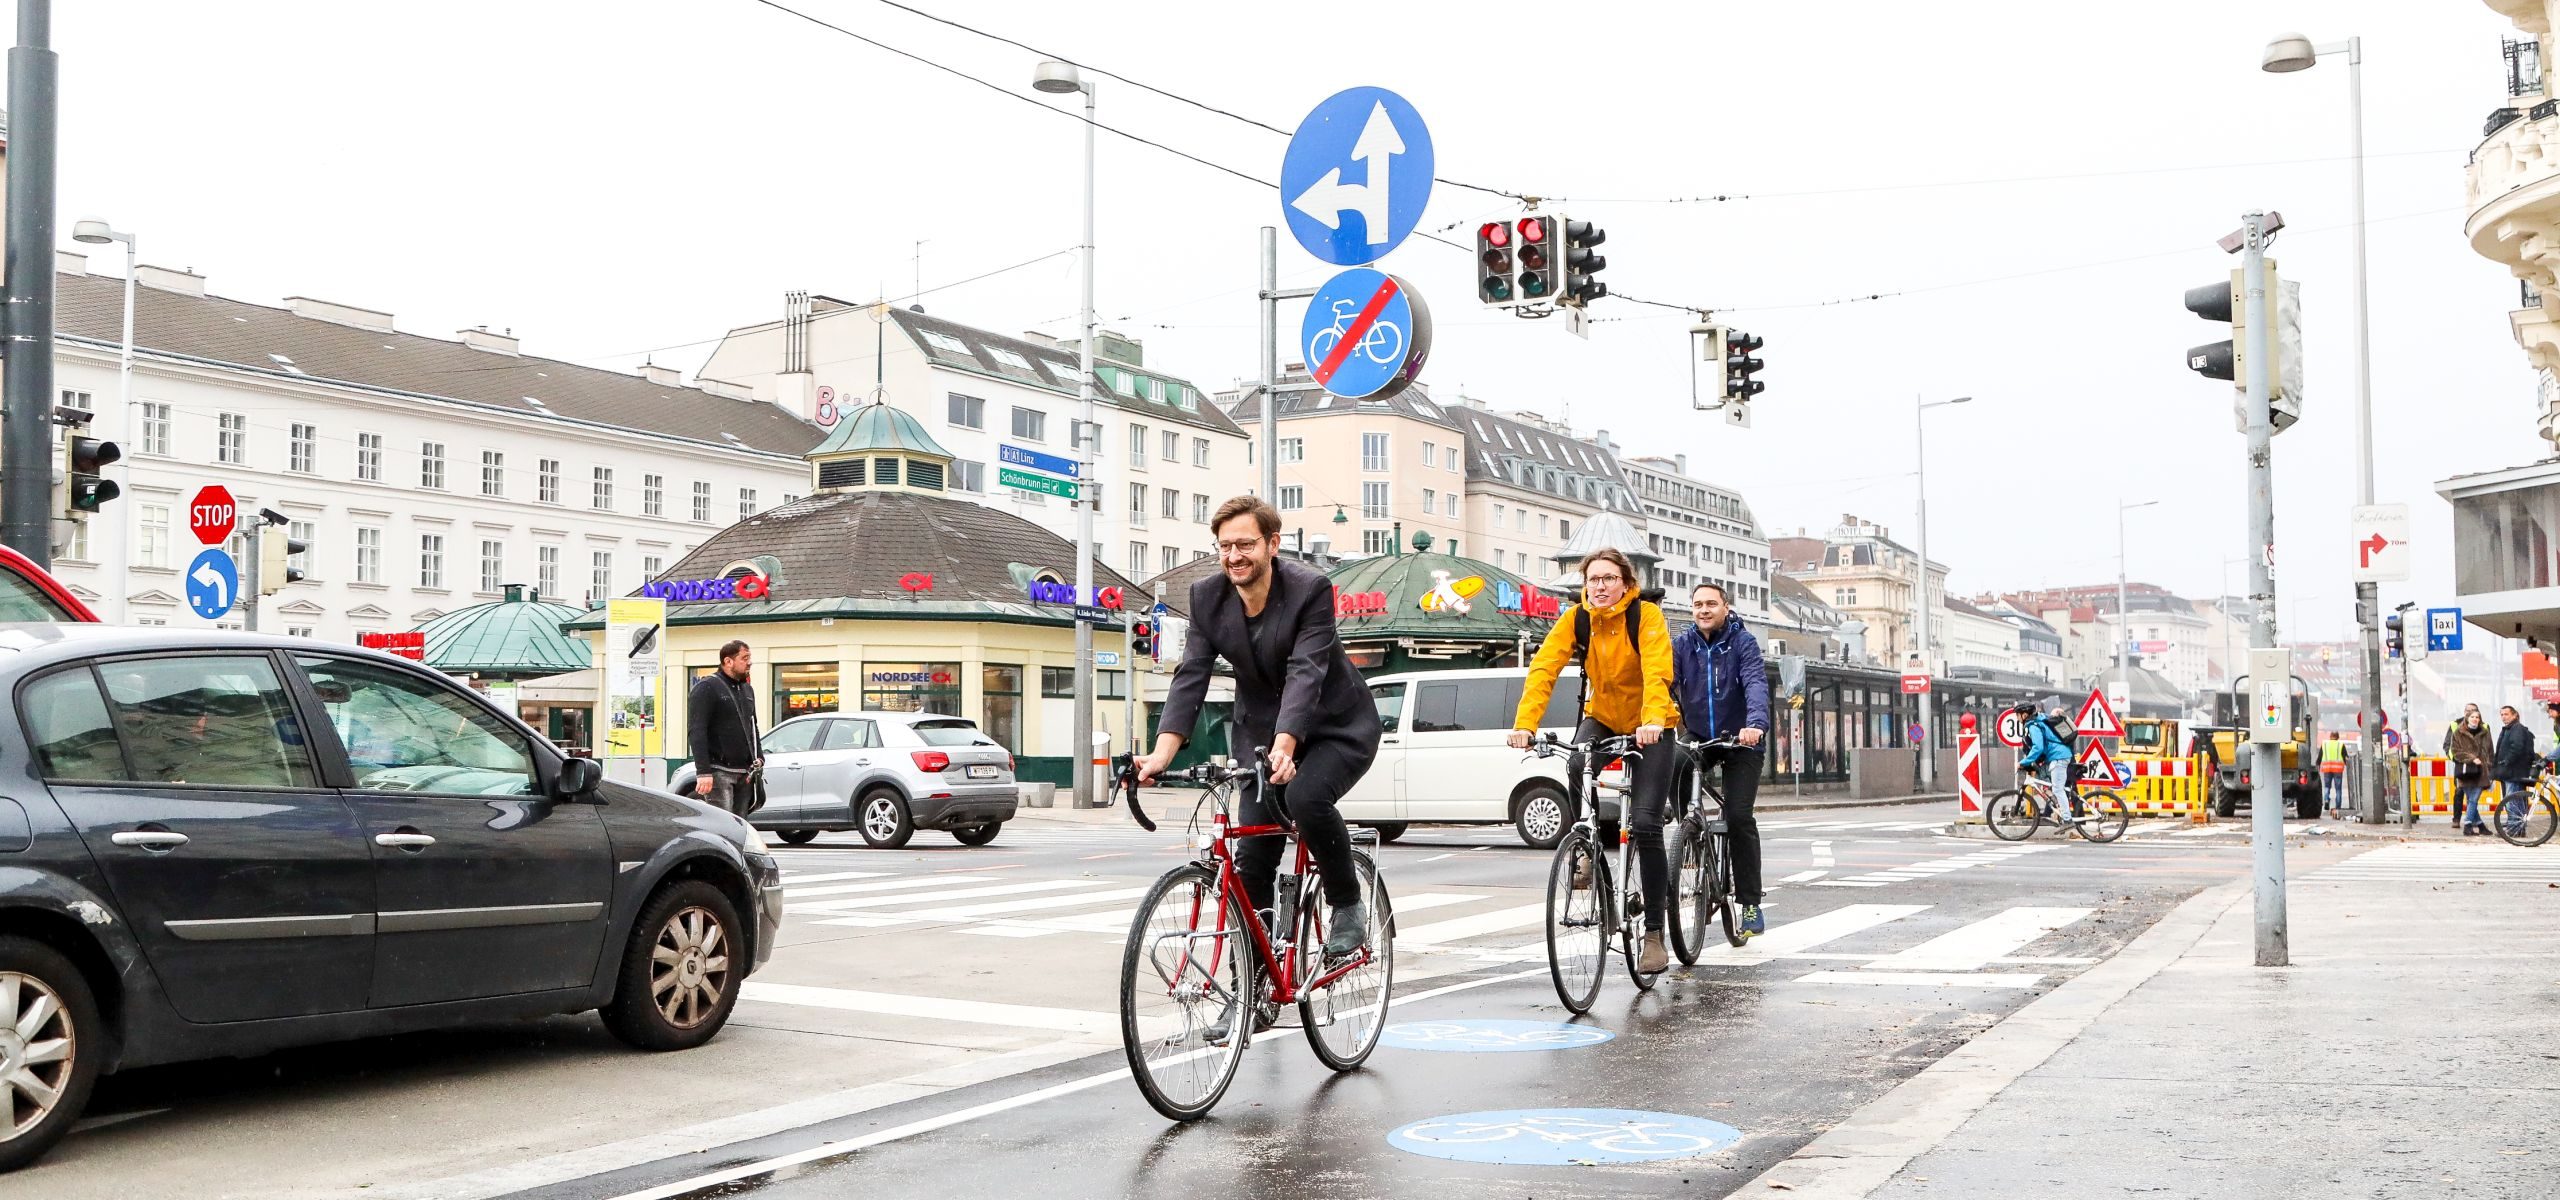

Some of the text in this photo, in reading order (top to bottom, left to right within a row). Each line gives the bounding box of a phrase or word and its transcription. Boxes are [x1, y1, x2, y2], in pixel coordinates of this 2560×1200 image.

[2194, 357, 2206, 367] 13
[1021, 452, 1034, 465] Linz
[1001, 471, 1041, 489] Schönbrunn
[193, 504, 233, 527] STOP
[643, 578, 734, 602] NORDSEE
[1333, 585, 1387, 614] ann
[2434, 618, 2454, 629] Taxi
[871, 672, 930, 682] NORDSEE
[2006, 718, 2025, 738] 30
